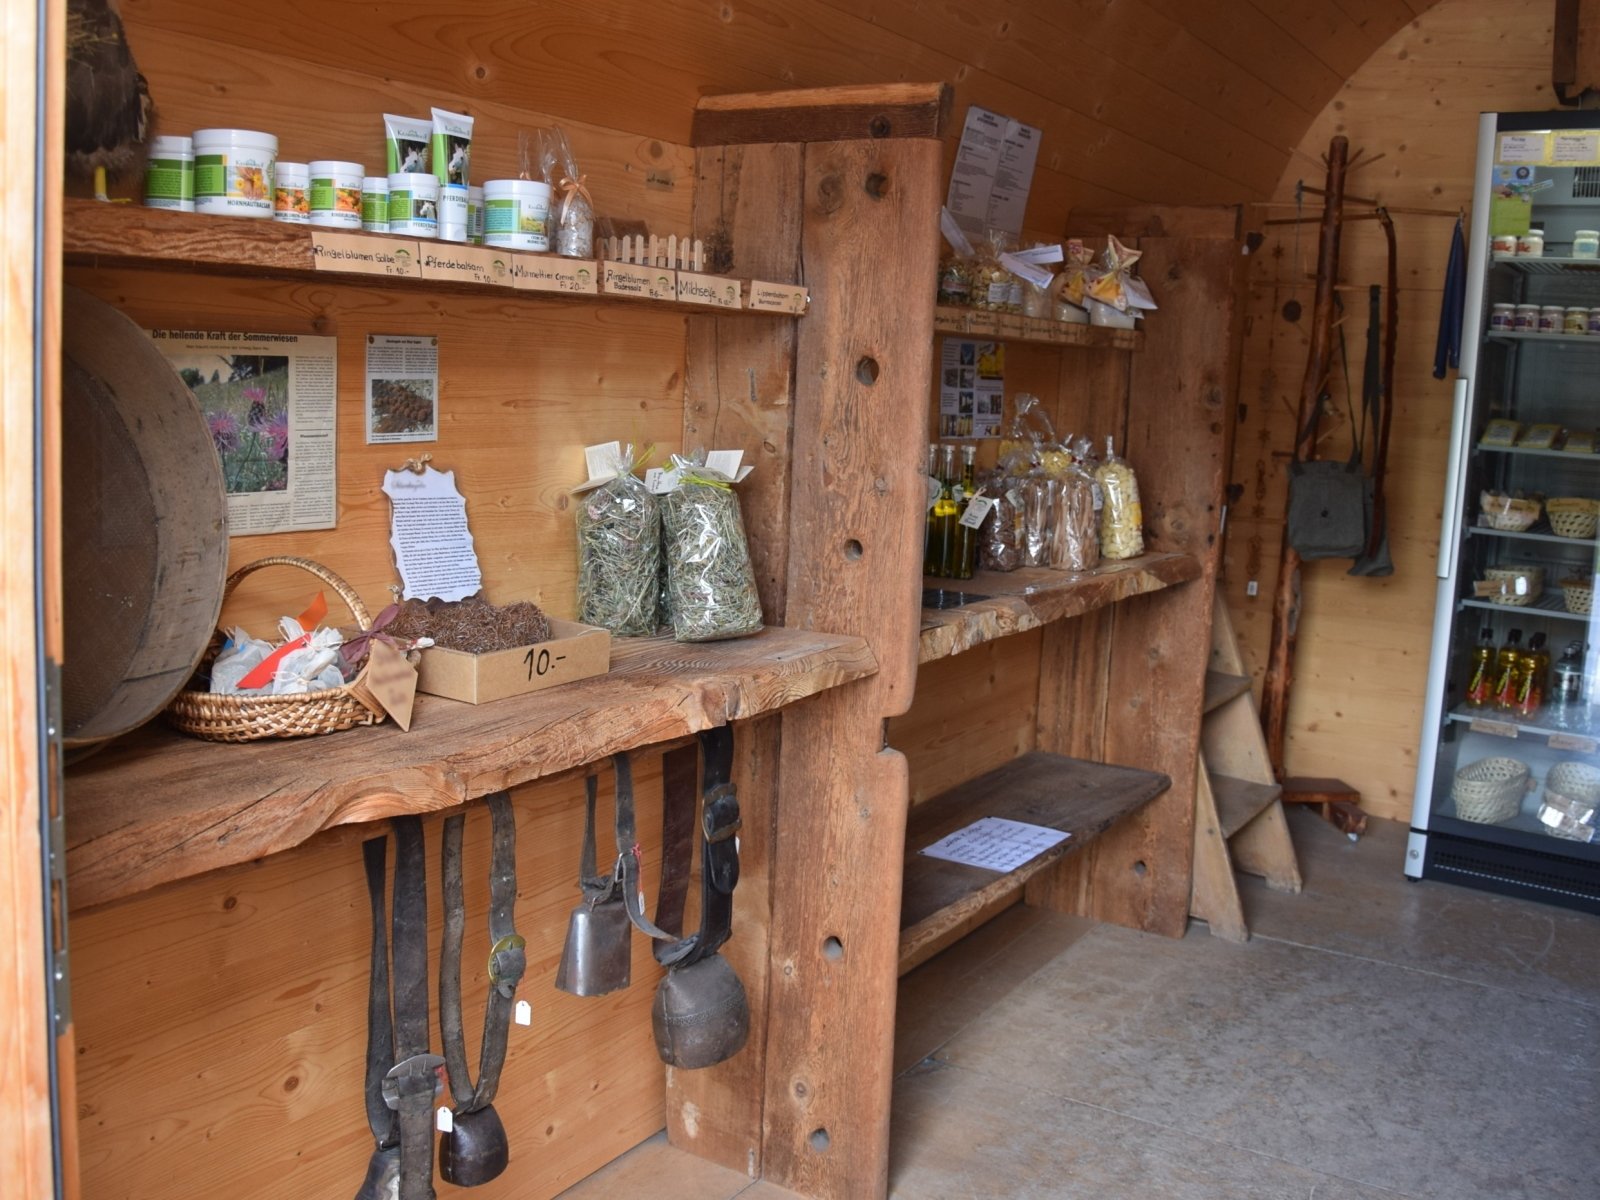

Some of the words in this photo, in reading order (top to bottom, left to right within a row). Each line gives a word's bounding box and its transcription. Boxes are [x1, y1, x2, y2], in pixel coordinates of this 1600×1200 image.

[315, 244, 373, 262] Ringelblumen
[426, 255, 485, 273] Pferdebalsam
[606, 269, 651, 286] Ringelblumen
[680, 279, 717, 303] Milchseife
[152, 329, 166, 339] Die
[169, 329, 204, 340] heilende
[207, 331, 226, 341] Kraft
[228, 332, 241, 341] der
[243, 333, 298, 343] Sommerwiesen
[523, 648, 566, 682] 10.-
